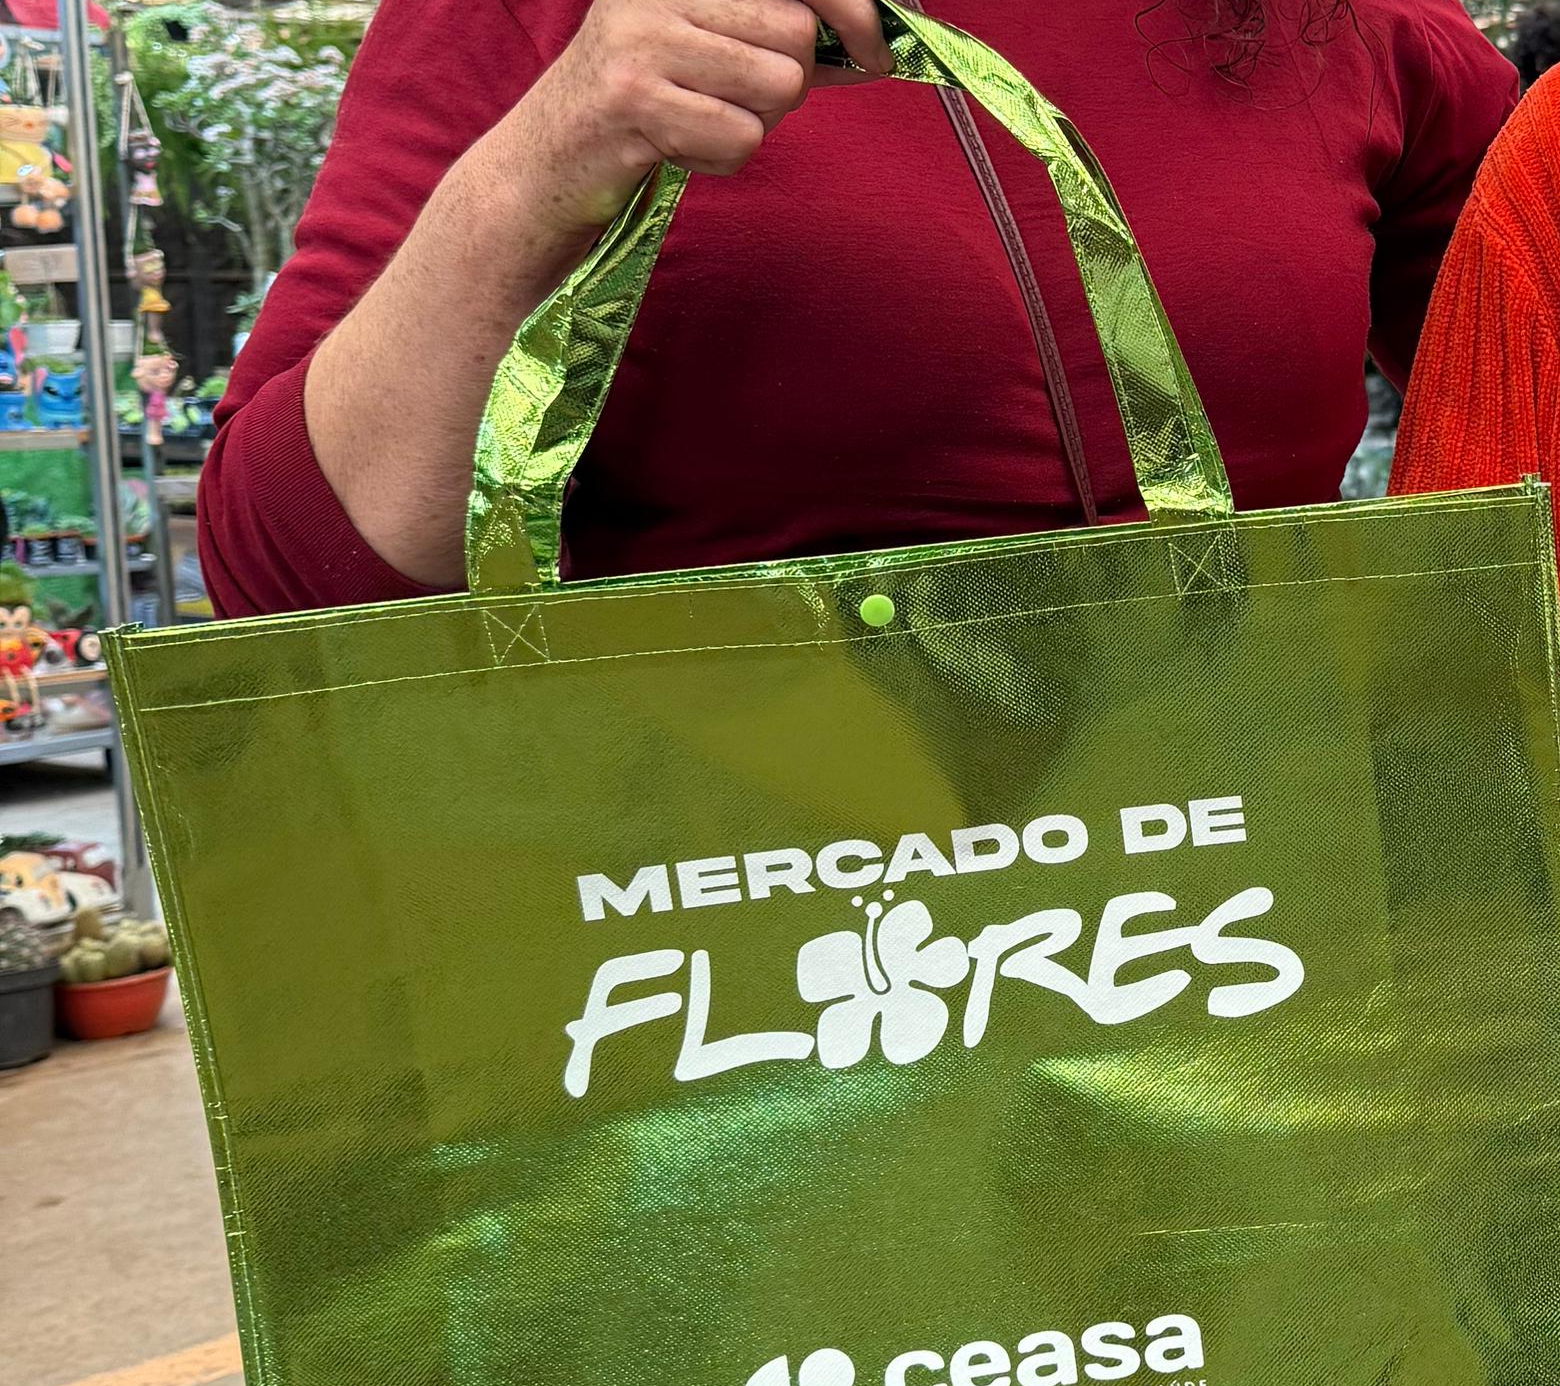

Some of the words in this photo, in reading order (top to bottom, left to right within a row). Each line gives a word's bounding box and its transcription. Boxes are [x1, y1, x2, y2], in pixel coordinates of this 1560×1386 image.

[576, 814, 1089, 921] MERCADO
[1119, 795, 1248, 856] DE
[563, 886, 1306, 1099] FLORES
